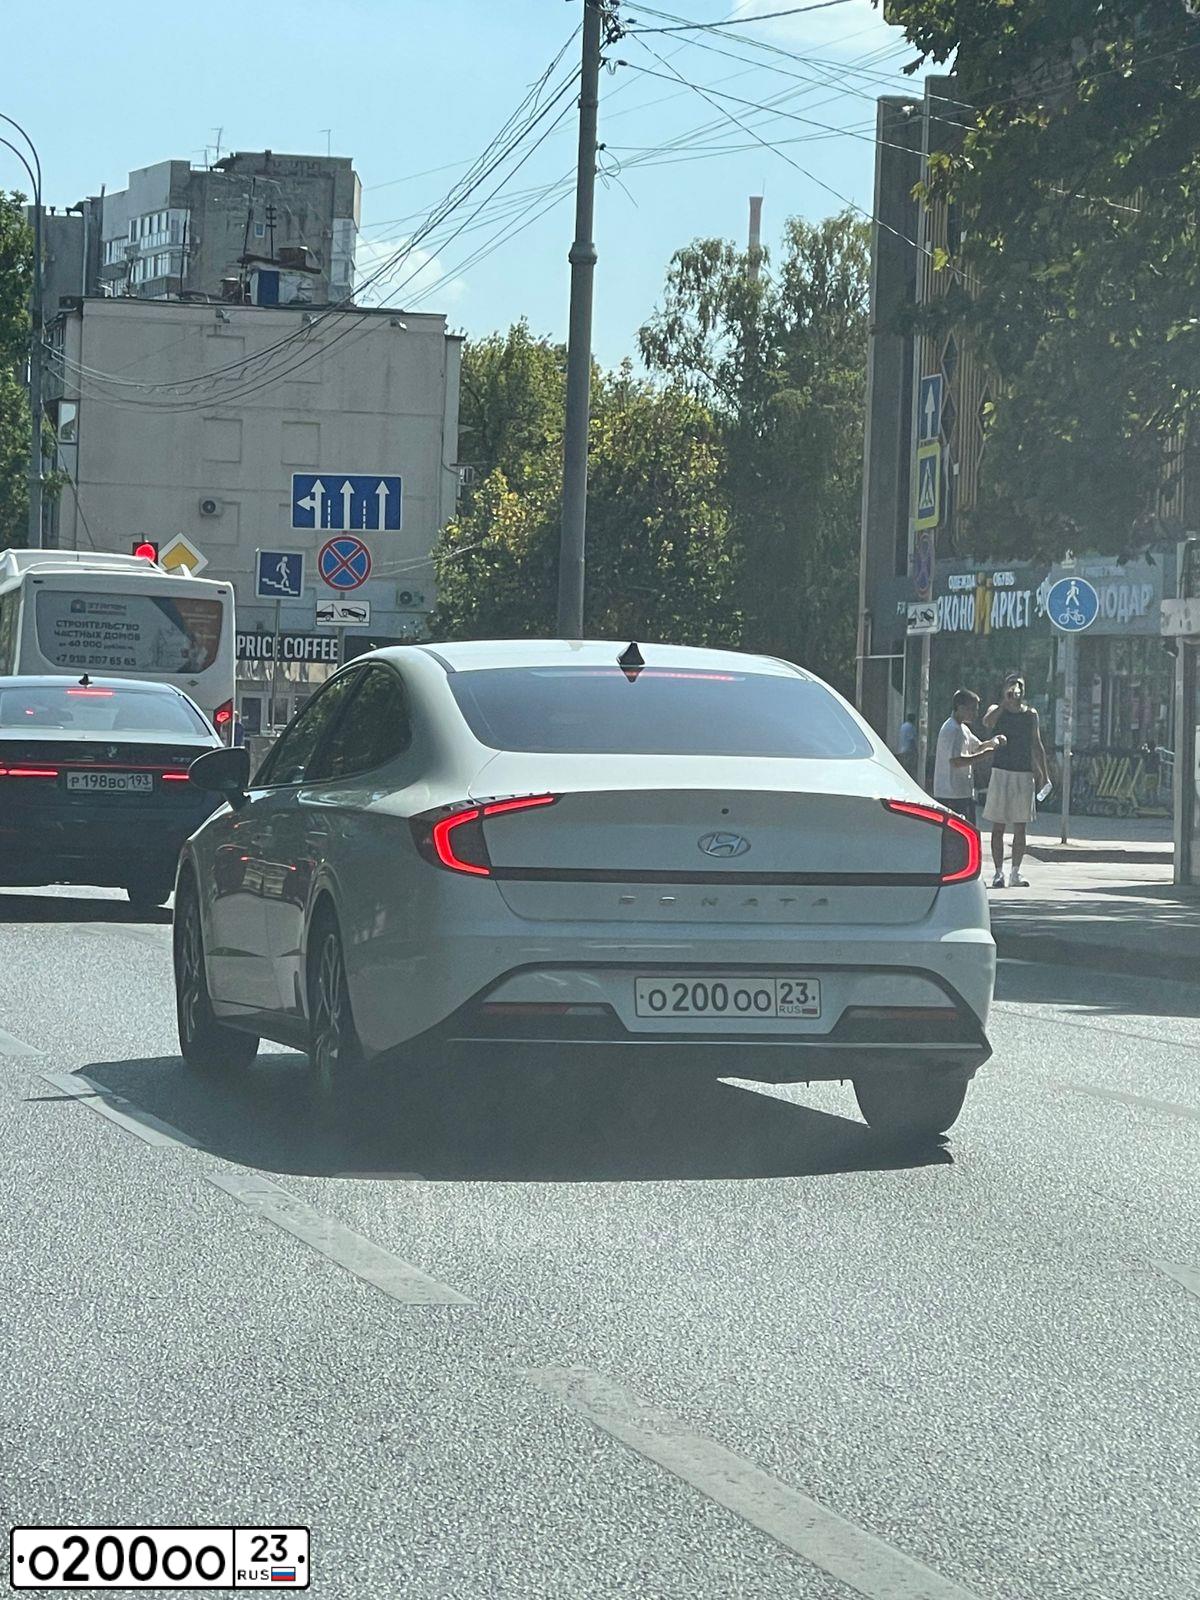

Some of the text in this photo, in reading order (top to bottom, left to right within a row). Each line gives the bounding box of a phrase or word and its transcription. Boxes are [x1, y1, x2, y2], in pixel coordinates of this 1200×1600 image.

[948, 571, 1015, 590] ОДЕЖДА ОБУВЬ
[56, 619, 140, 631] СТРОИТЕЛЬСТВО
[54, 629, 141, 641] ЧАСТНЫХ ДОМОВ
[236, 634, 338, 660] PRICE COFFEE
[71, 774, 150, 789] Р198ВО 193
[648, 982, 809, 1012] О200ОО 23
[779, 1005, 801, 1014] RUS
